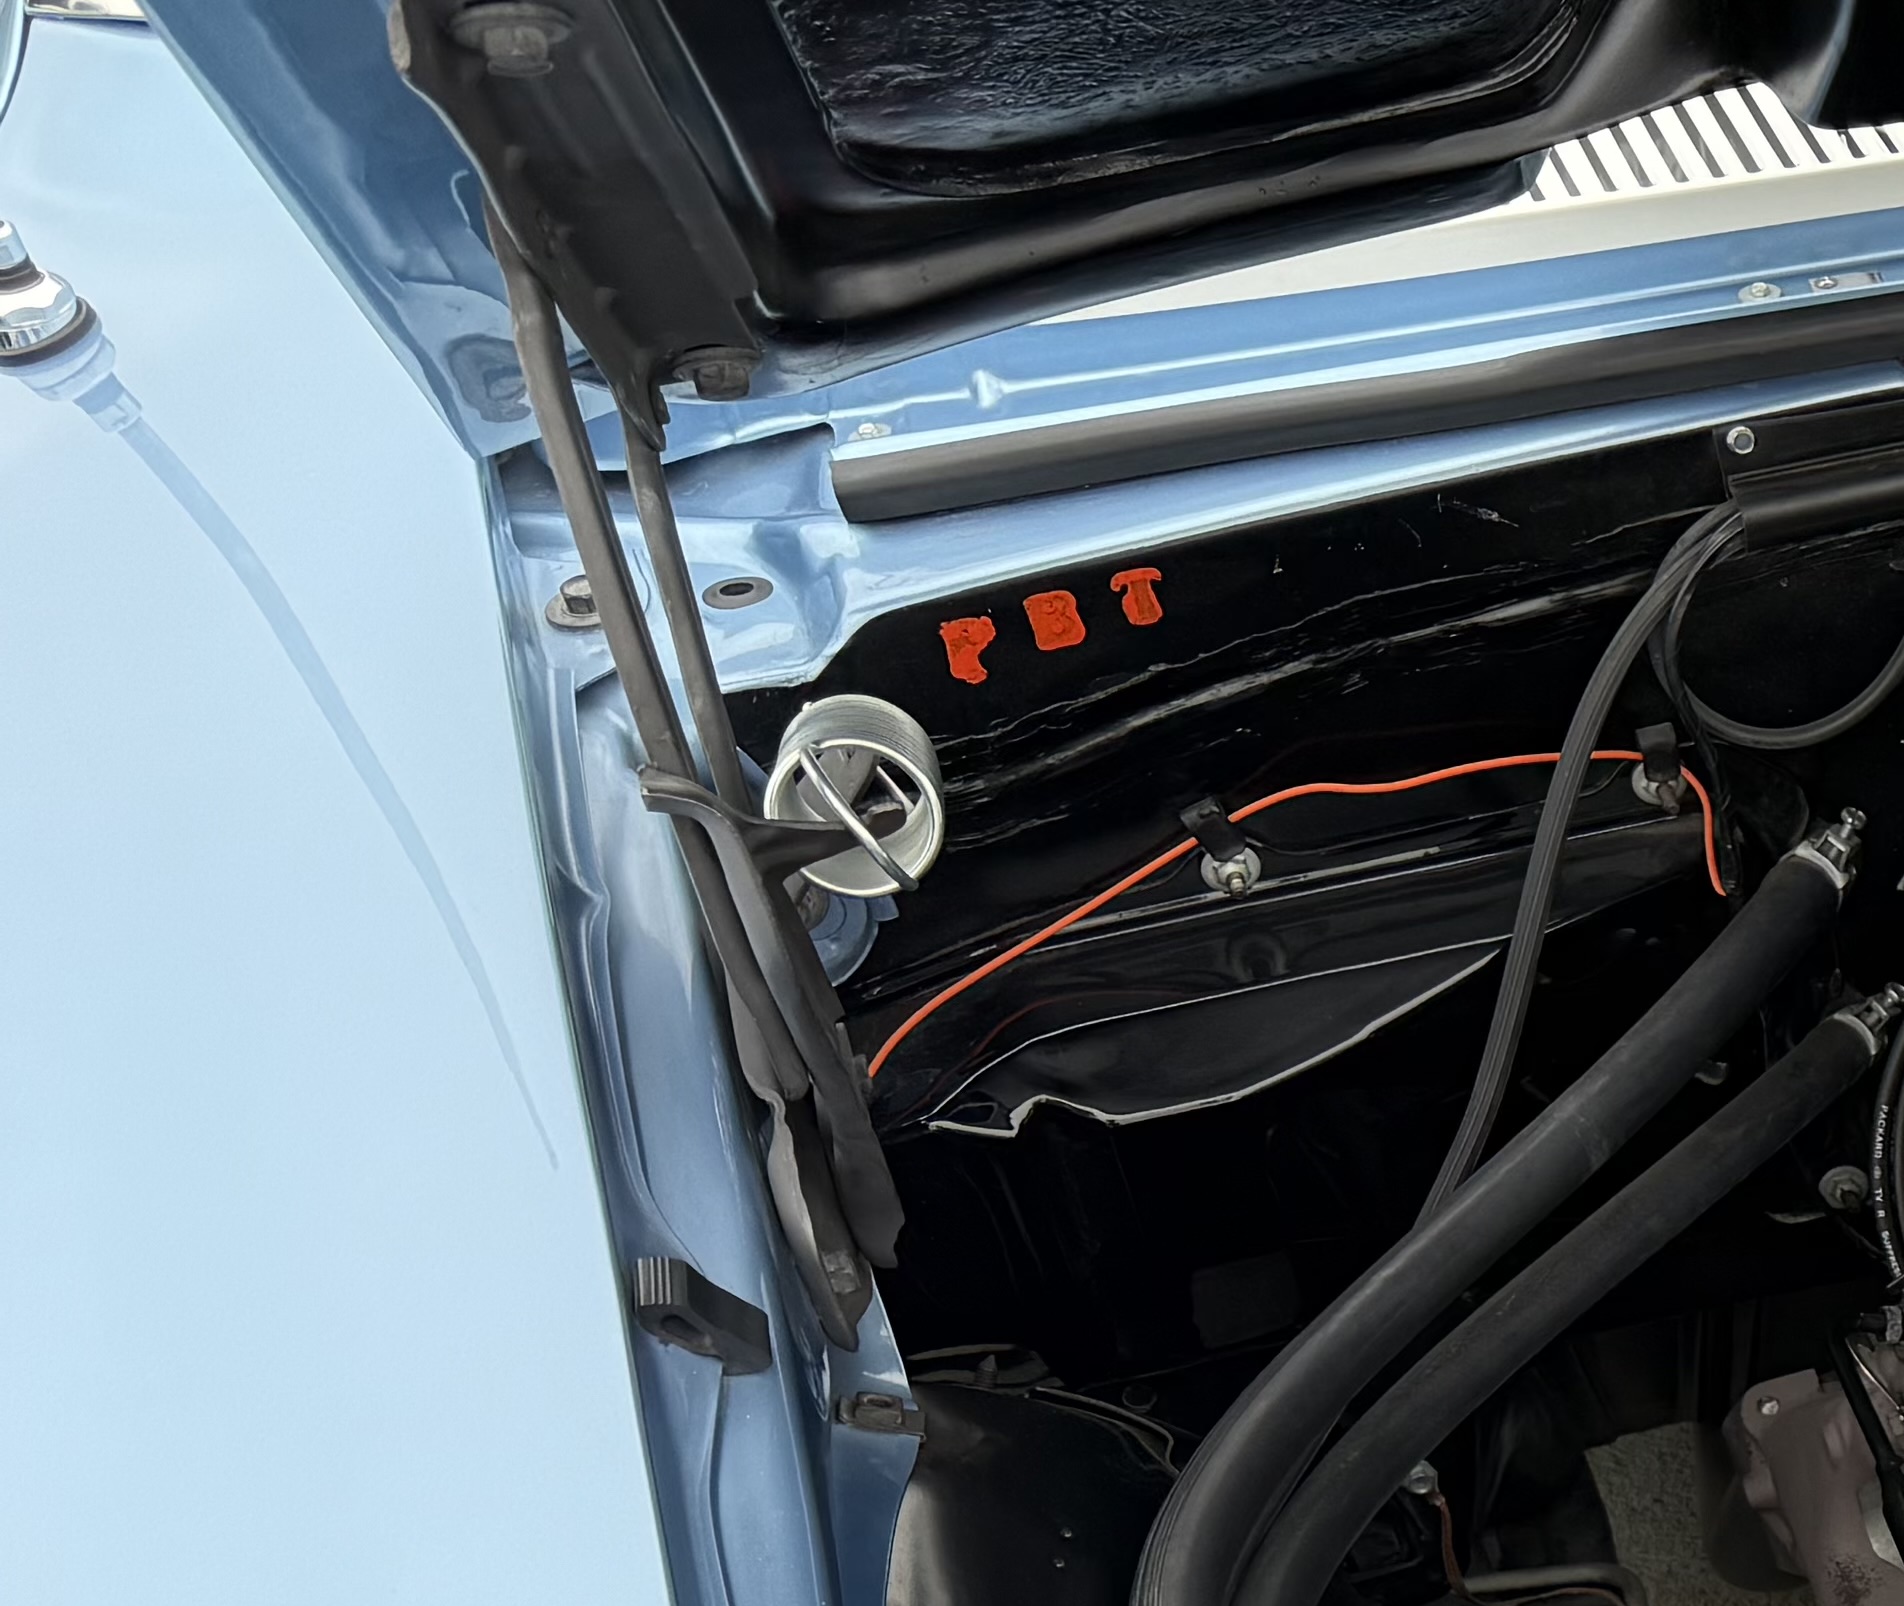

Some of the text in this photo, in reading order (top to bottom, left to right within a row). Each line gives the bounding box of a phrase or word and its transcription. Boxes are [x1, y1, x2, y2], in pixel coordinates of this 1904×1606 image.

[1873, 1104, 1888, 1217] PACKARD TV R
